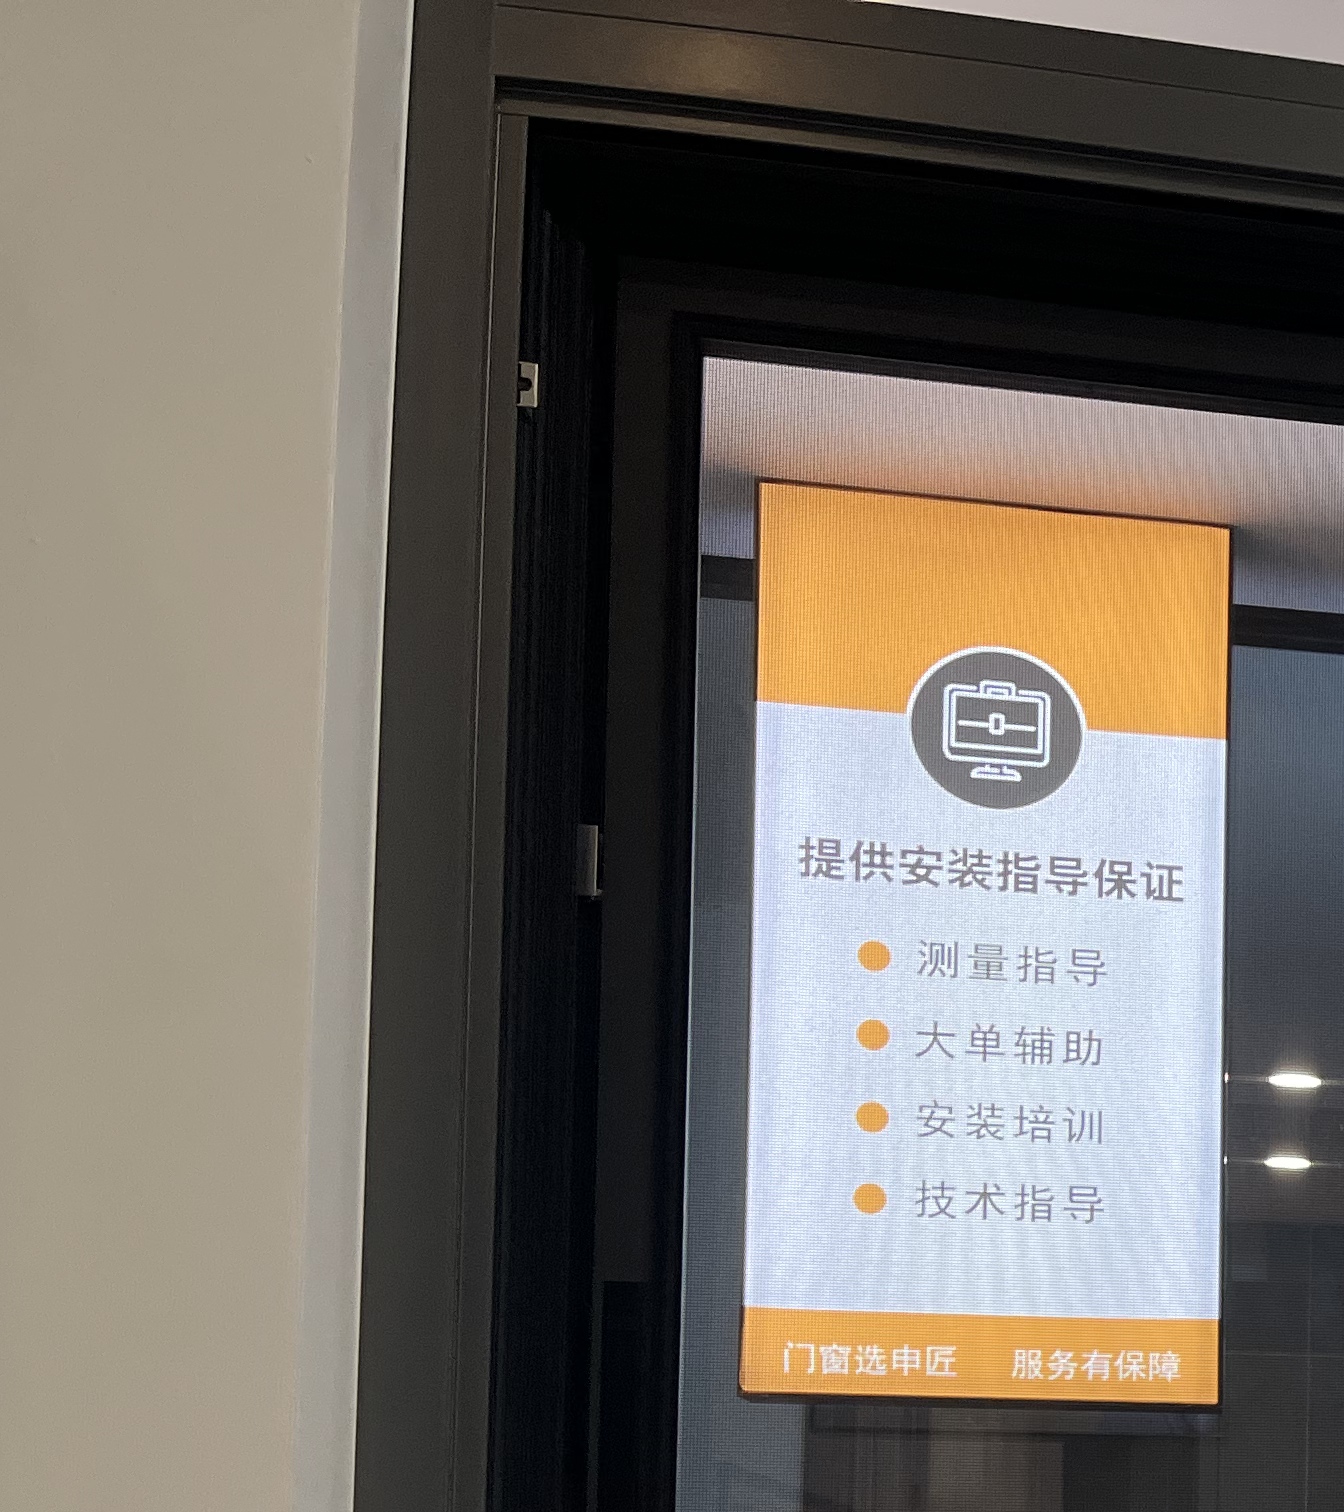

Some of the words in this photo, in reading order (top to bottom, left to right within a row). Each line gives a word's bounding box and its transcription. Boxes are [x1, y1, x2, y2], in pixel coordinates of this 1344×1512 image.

[798, 836, 1186, 904] 提供安装指导保证
[916, 940, 1108, 987] 测量指导
[915, 1022, 1104, 1067] 大单辅助
[916, 1101, 1105, 1145] 安装培训
[915, 1181, 1106, 1225] 技术指导
[783, 1340, 958, 1378] 门窗选申匠
[1011, 1348, 1181, 1384] 服务有保障
